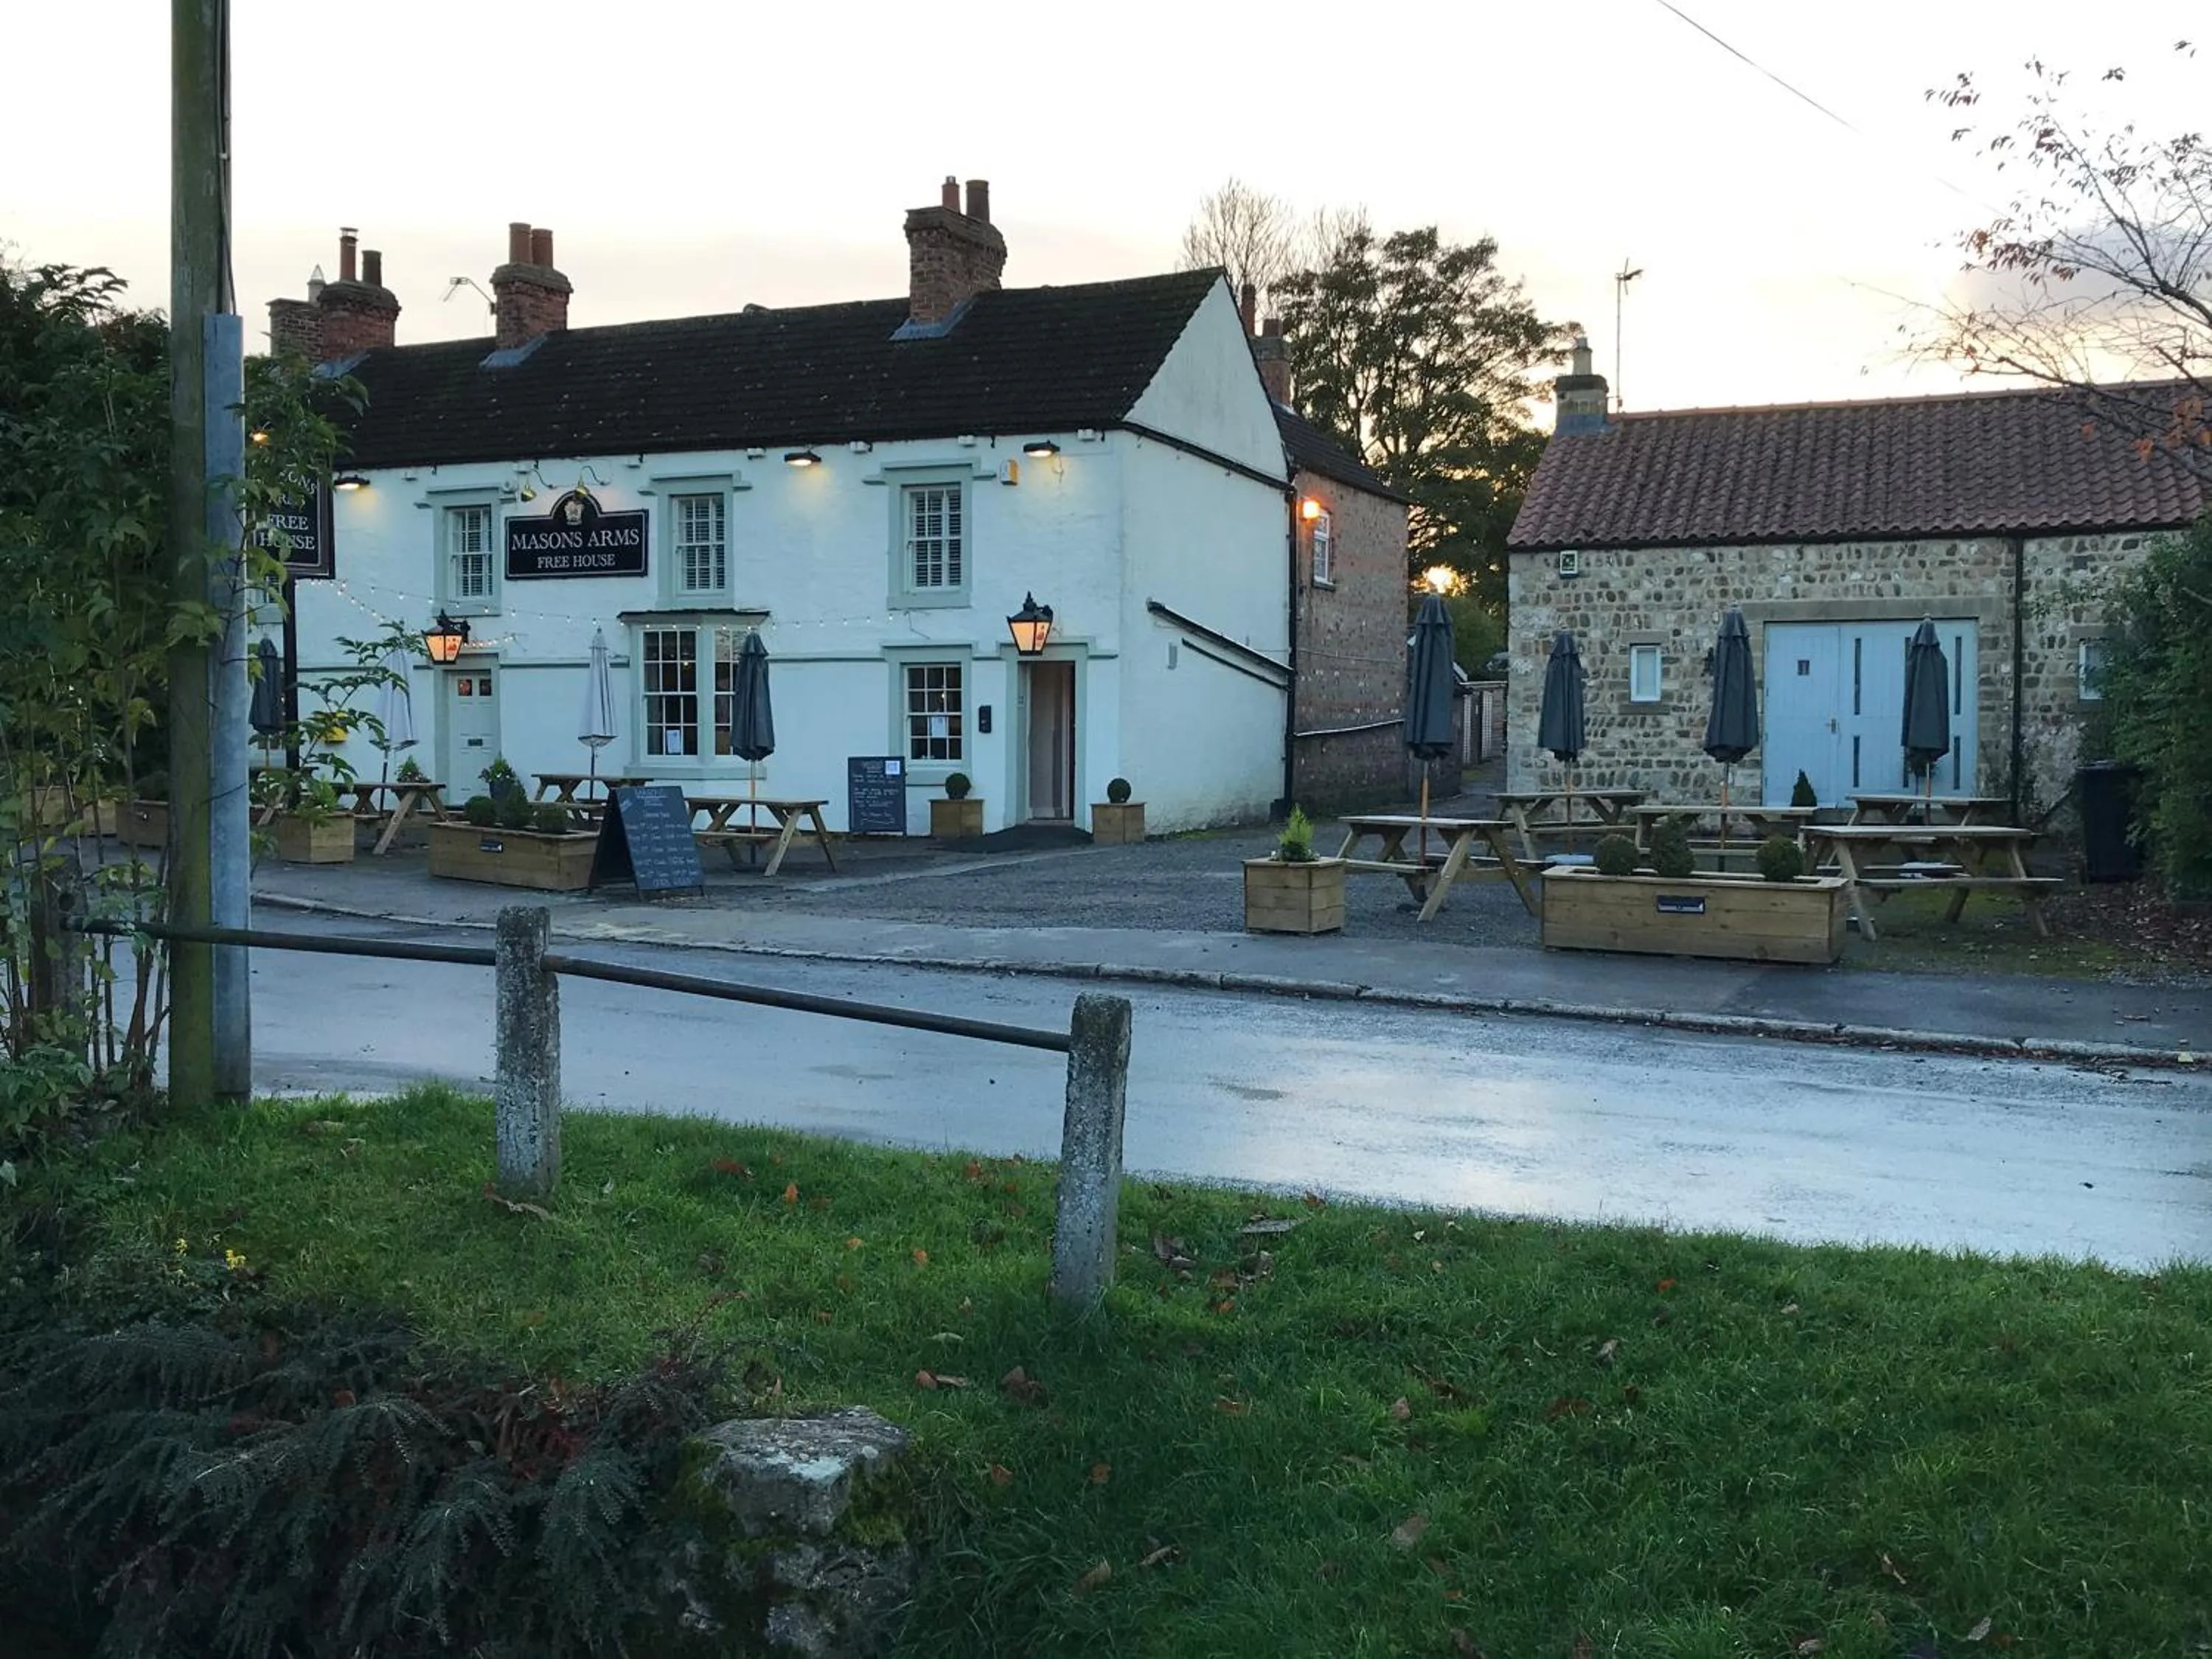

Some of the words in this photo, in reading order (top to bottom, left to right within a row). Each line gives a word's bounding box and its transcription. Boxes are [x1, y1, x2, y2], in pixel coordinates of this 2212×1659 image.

[268, 514, 309, 530] FREE
[259, 532, 316, 549] HUSE
[512, 532, 582, 550] MASONS
[588, 529, 639, 546] ARMS
[538, 556, 569, 568] FREE
[573, 554, 616, 567] HOUSE
